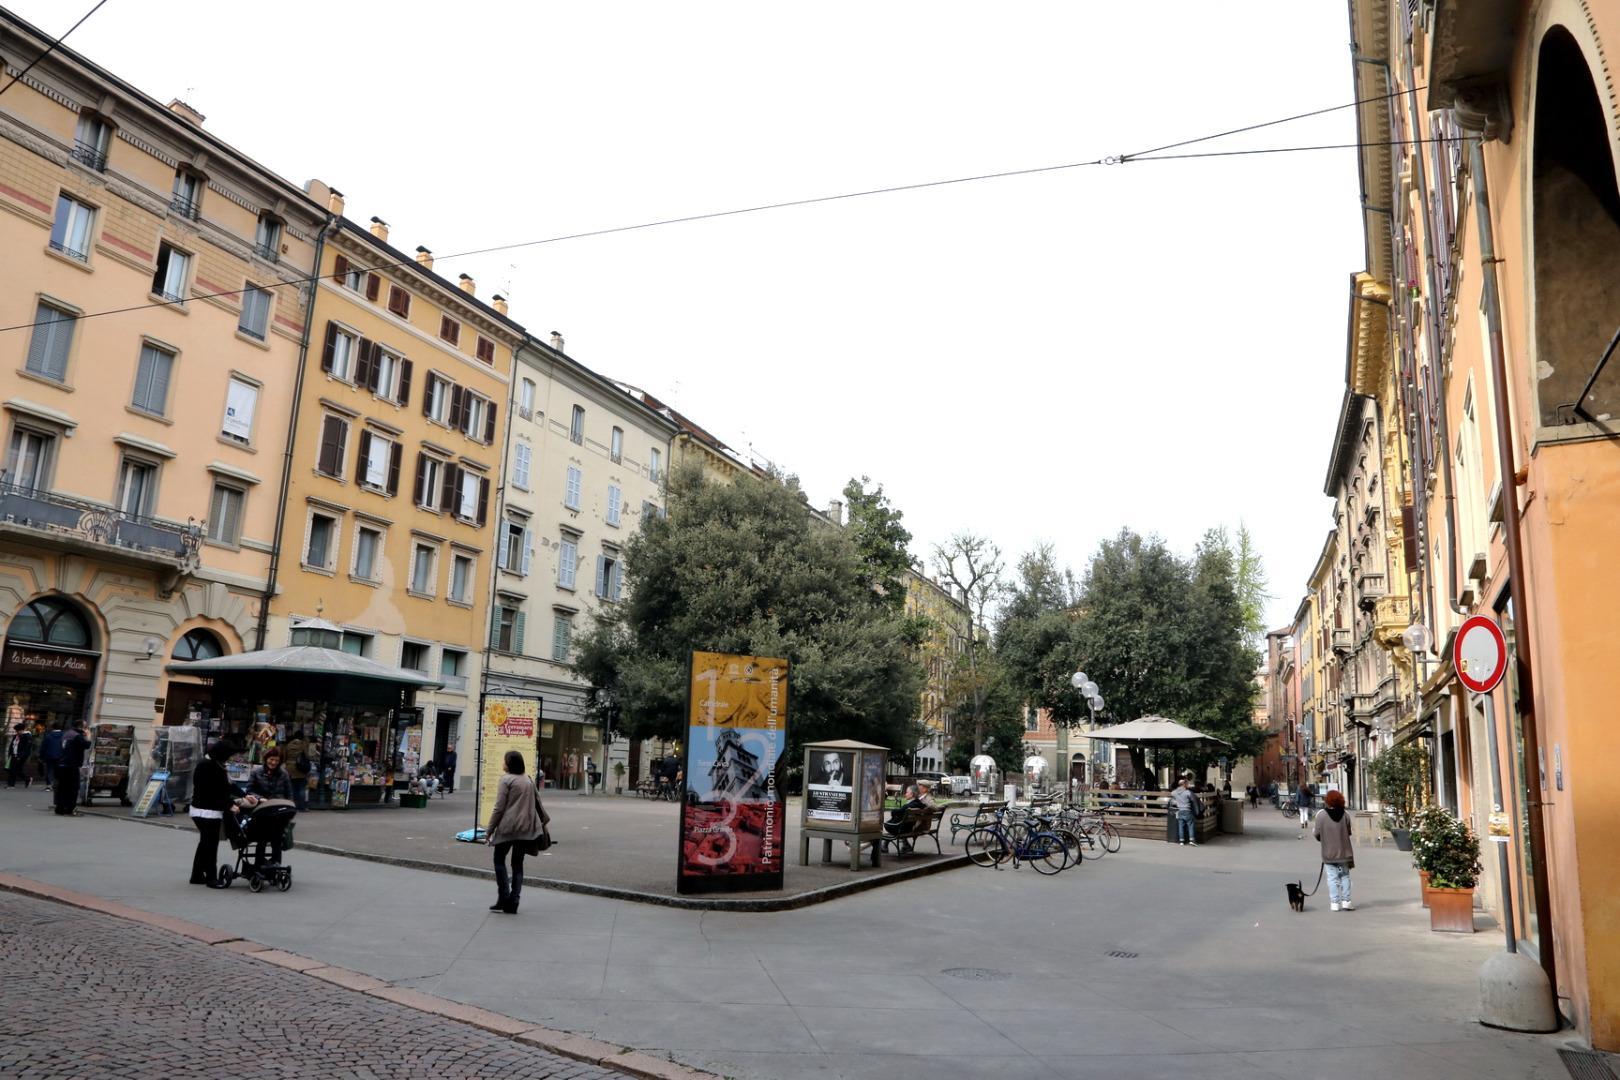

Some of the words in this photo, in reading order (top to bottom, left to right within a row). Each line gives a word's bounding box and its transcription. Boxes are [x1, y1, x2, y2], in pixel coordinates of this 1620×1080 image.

[21, 652, 52, 669] boutique
[53, 656, 61, 667] di
[767, 668, 779, 740] dell'umanità
[767, 740, 777, 797] mondiale
[762, 800, 775, 864] Patrimonio
